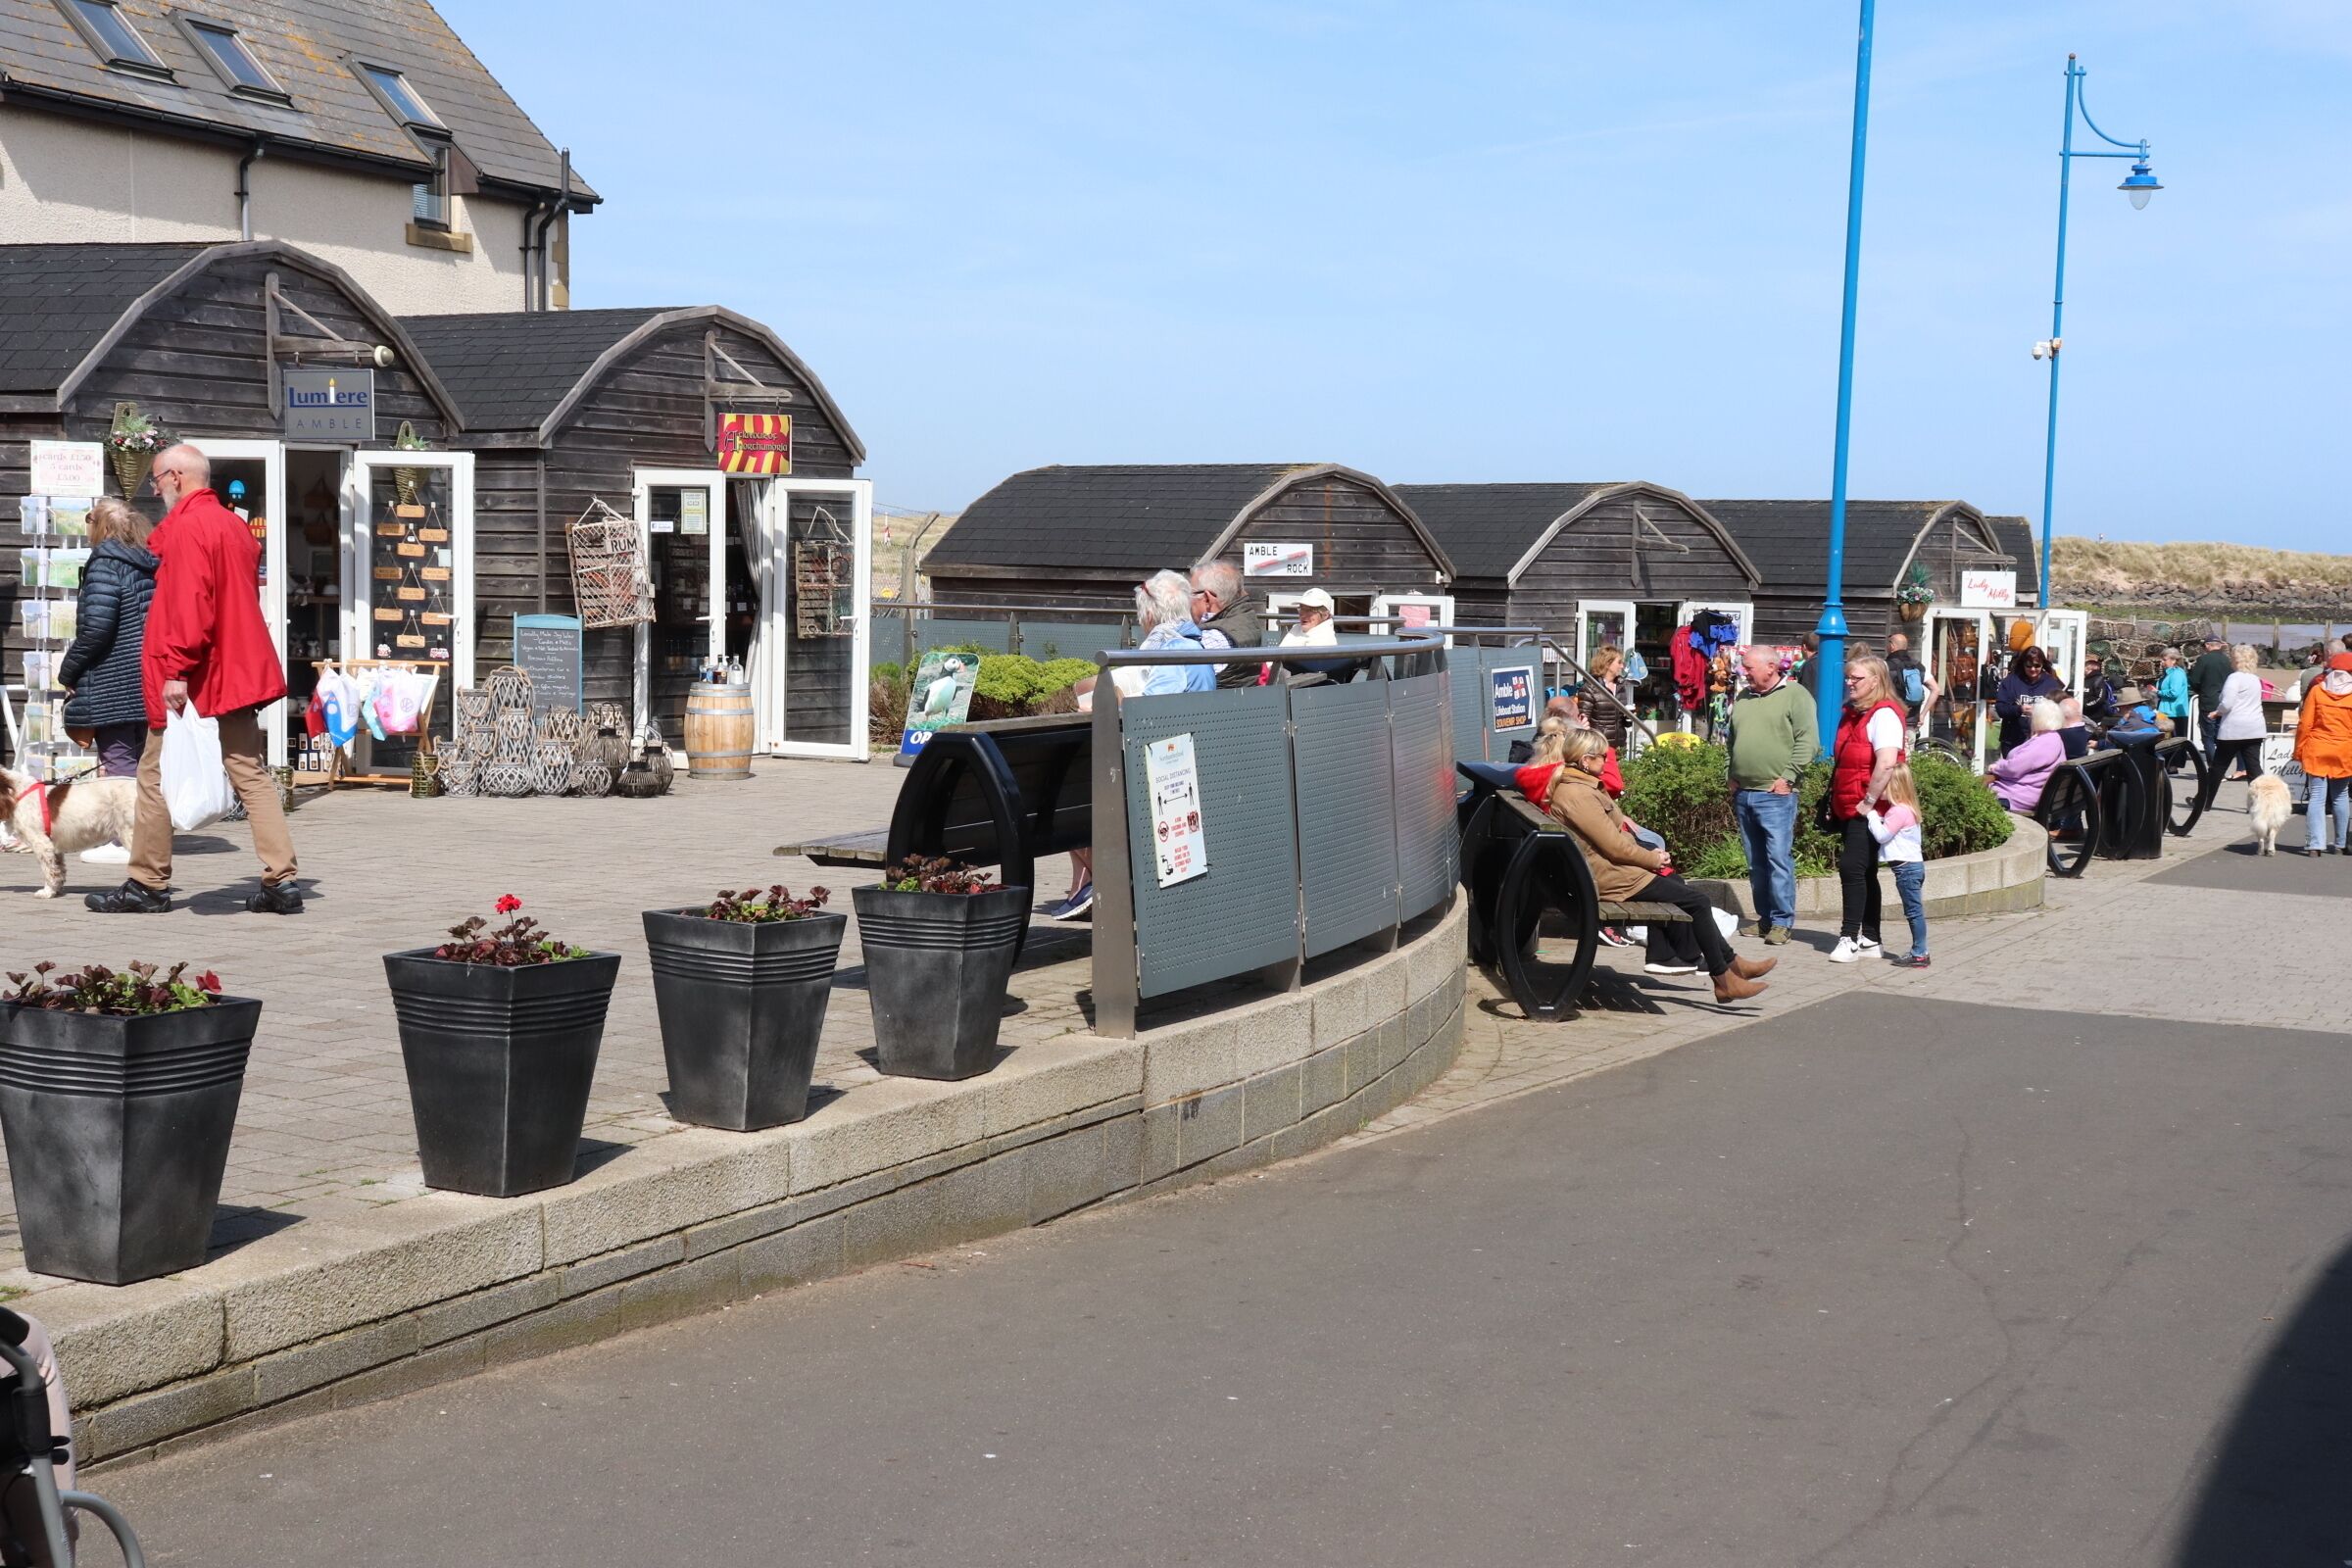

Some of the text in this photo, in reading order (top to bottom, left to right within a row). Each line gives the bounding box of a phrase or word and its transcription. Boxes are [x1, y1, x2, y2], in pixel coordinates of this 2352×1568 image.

[296, 418, 362, 429] AMBLE
[611, 538, 638, 552] RUM
[1250, 546, 1278, 556] AMBLE
[1287, 564, 1308, 573] ROCK
[636, 583, 650, 596] GIN
[1968, 578, 1988, 592] Lady
[1987, 588, 2010, 601] Milly
[1494, 683, 1513, 699] Amble
[1494, 703, 1526, 716] Lifeboat Station
[1495, 715, 1527, 728] SOUVENIR SHOP
[2267, 748, 2291, 760] Lad
[2270, 764, 2305, 777] Milly
